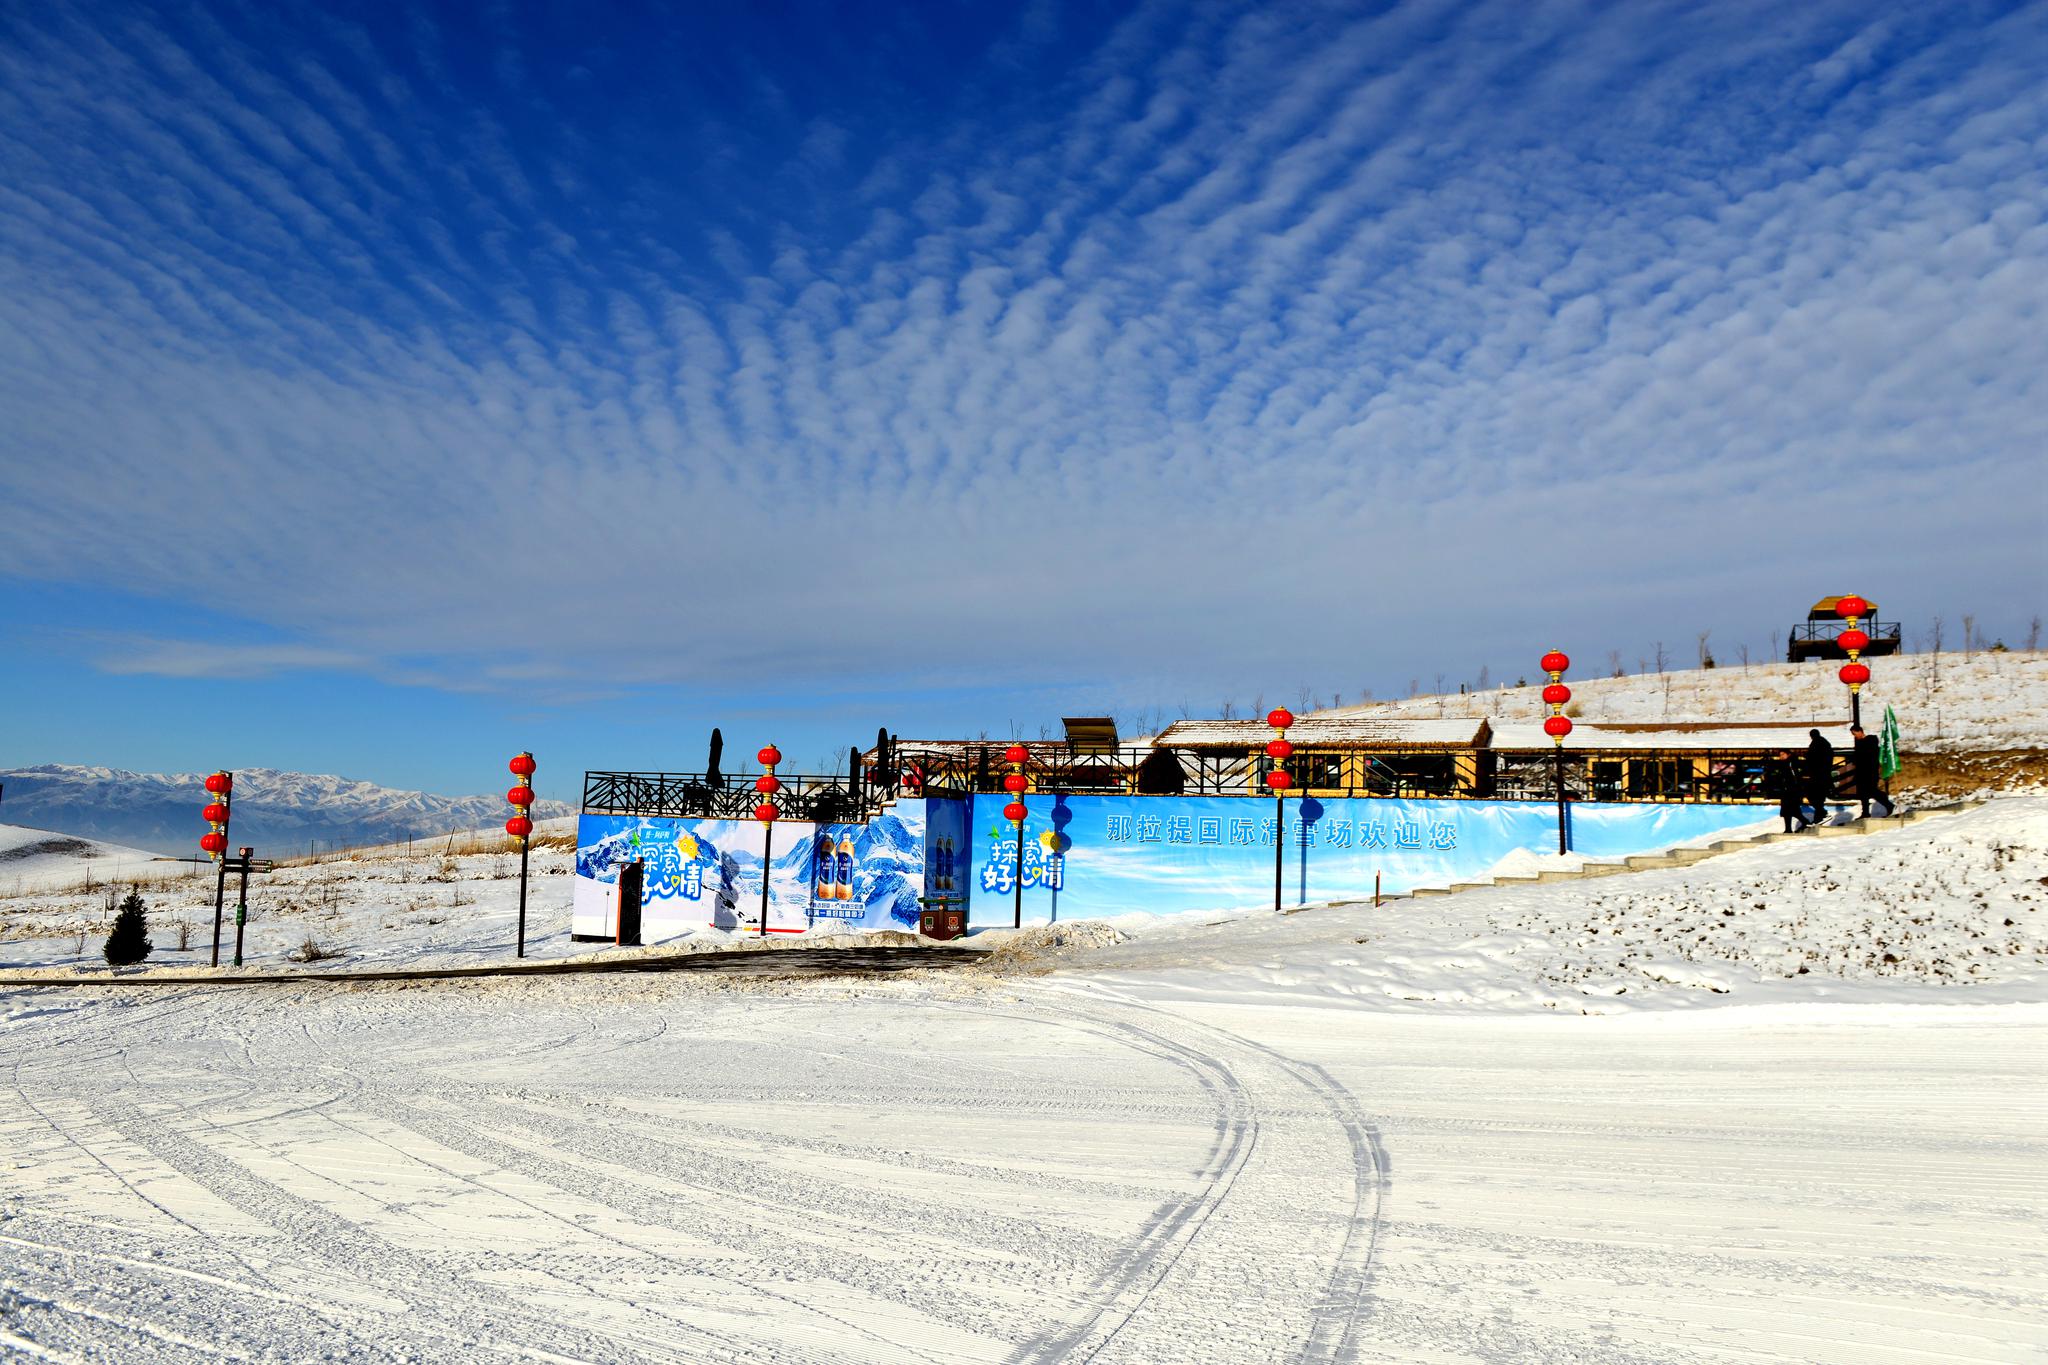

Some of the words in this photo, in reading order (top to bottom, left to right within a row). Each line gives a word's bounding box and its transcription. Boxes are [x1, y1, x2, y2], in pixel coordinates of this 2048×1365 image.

[1107, 814, 1457, 850] 那拉提国际滑雪场欢迎您
[632, 845, 679, 874] 探索
[991, 839, 1040, 865] 探索
[983, 857, 1062, 891] 好心情
